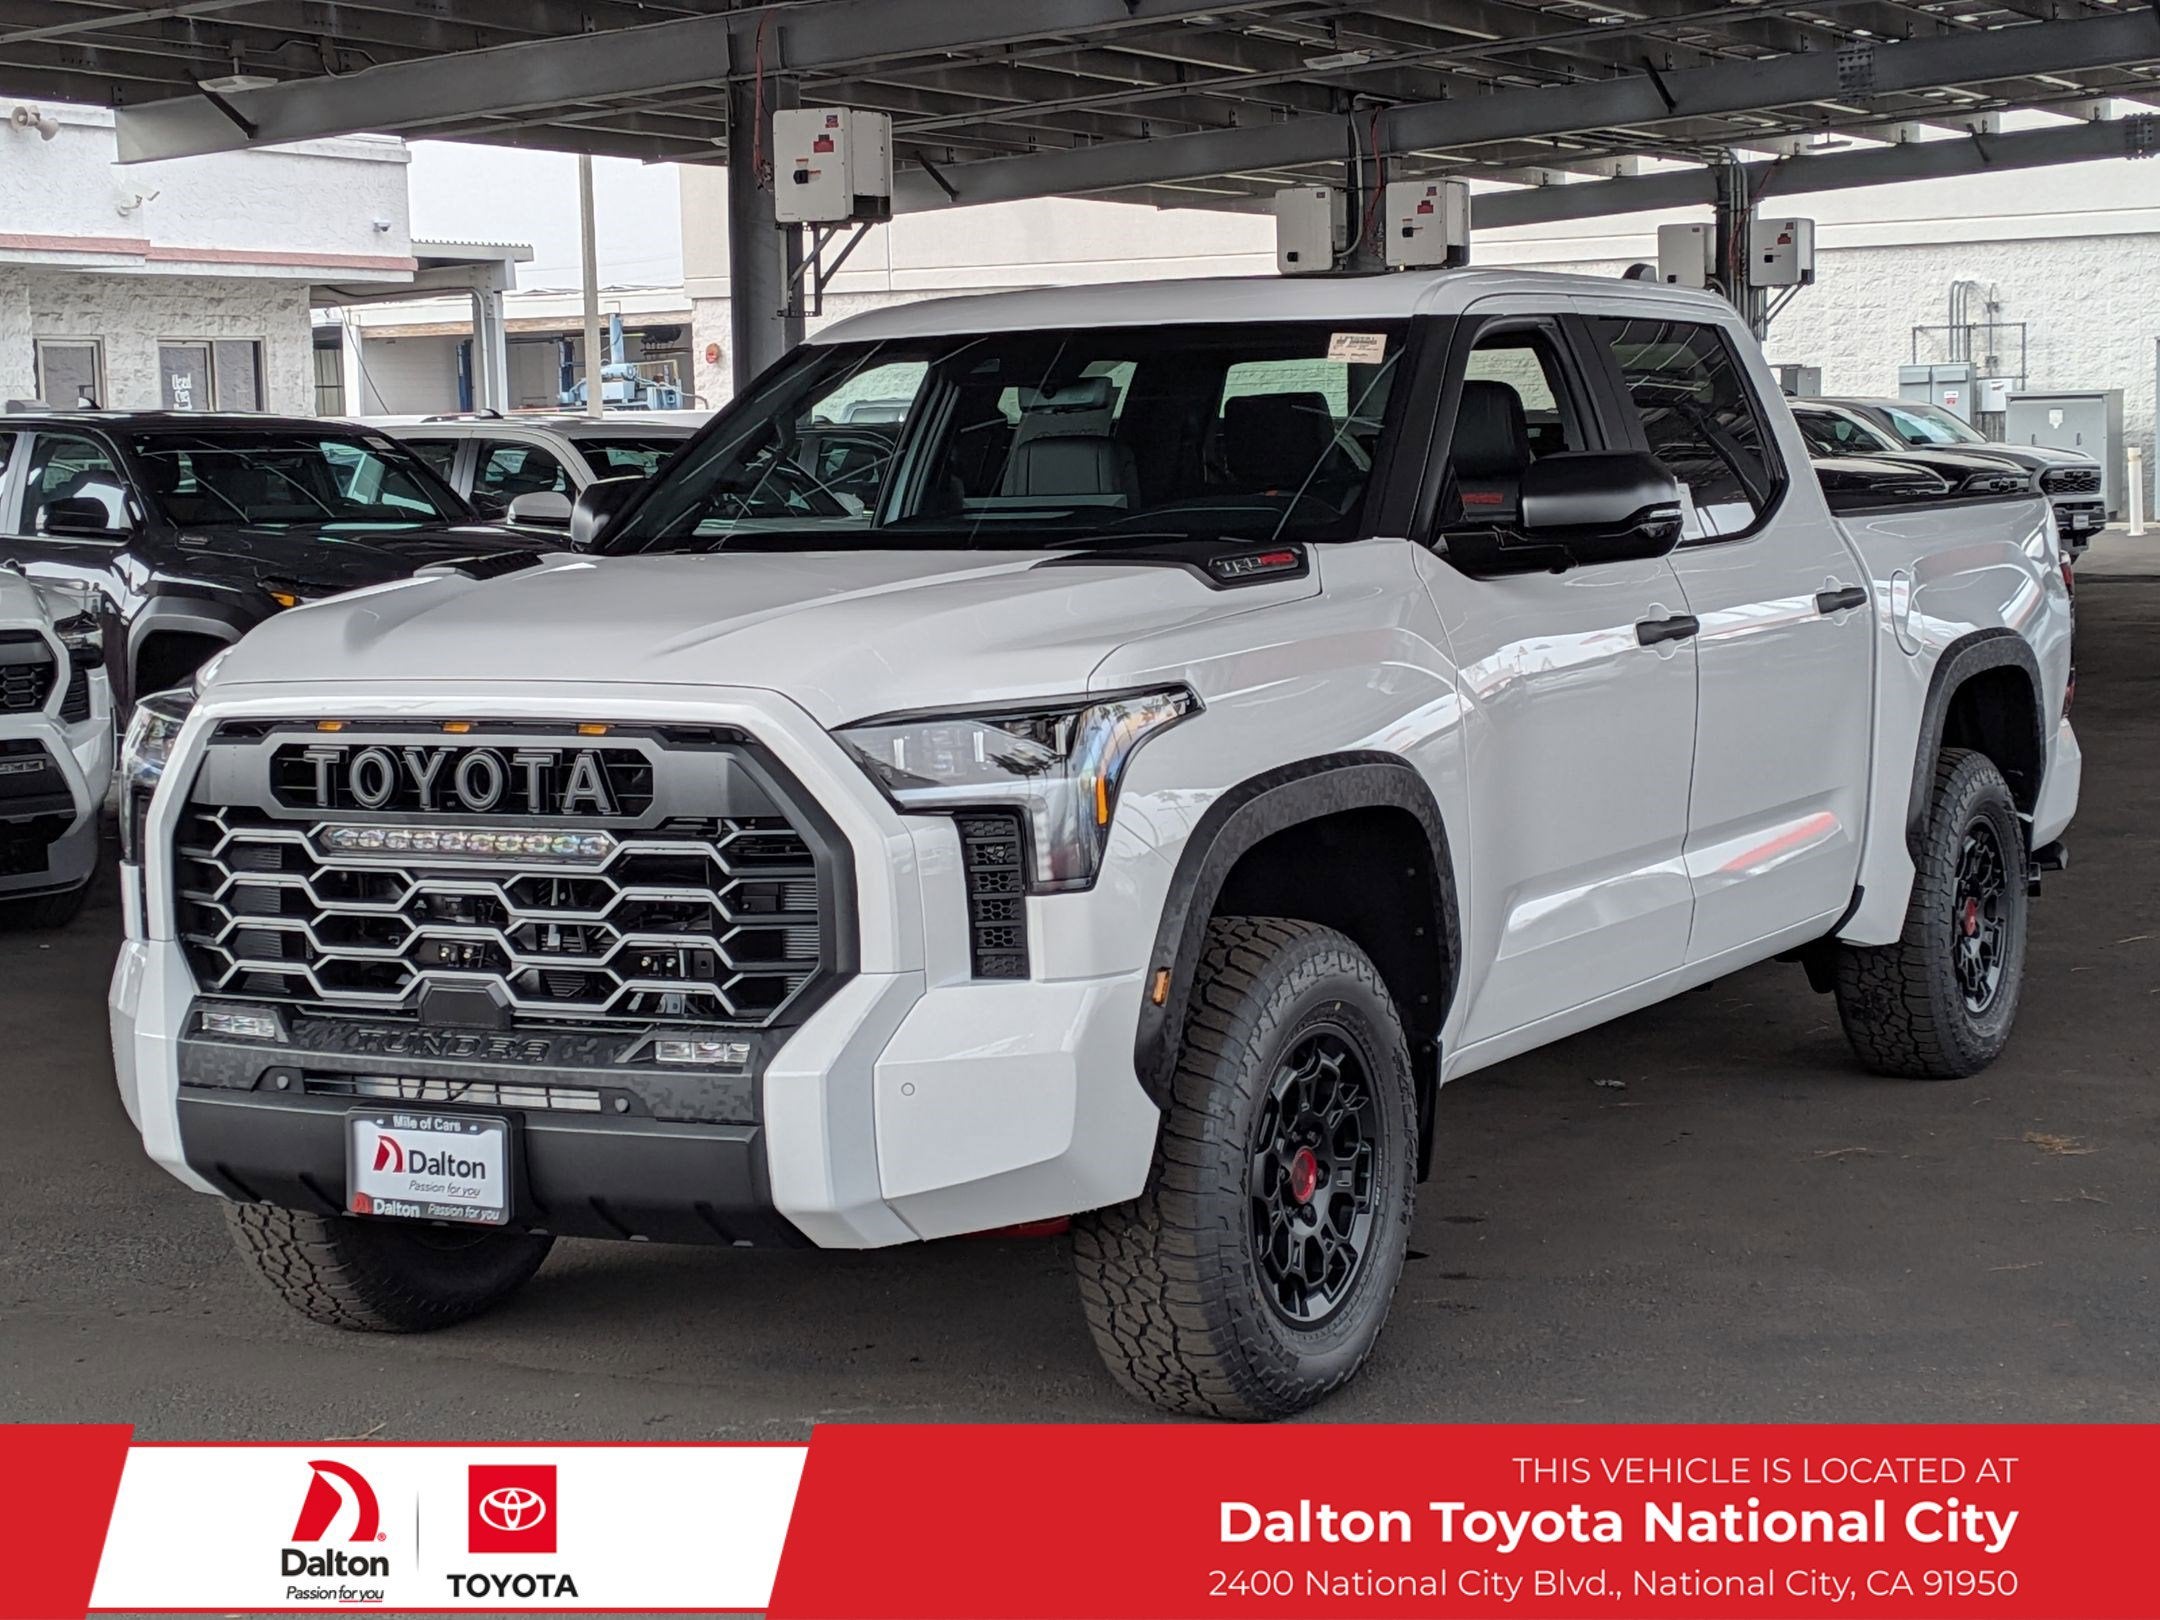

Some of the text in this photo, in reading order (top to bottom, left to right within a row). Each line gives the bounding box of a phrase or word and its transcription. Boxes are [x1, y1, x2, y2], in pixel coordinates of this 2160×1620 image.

[303, 746, 620, 815] TOYOTA
[359, 1029, 550, 1062] TUNDRA
[393, 1115, 461, 1132] Mile of Cars
[408, 1149, 486, 1180] Dalton
[409, 1180, 480, 1197] Passion for you
[373, 1199, 500, 1221] Dalton Passion for you
